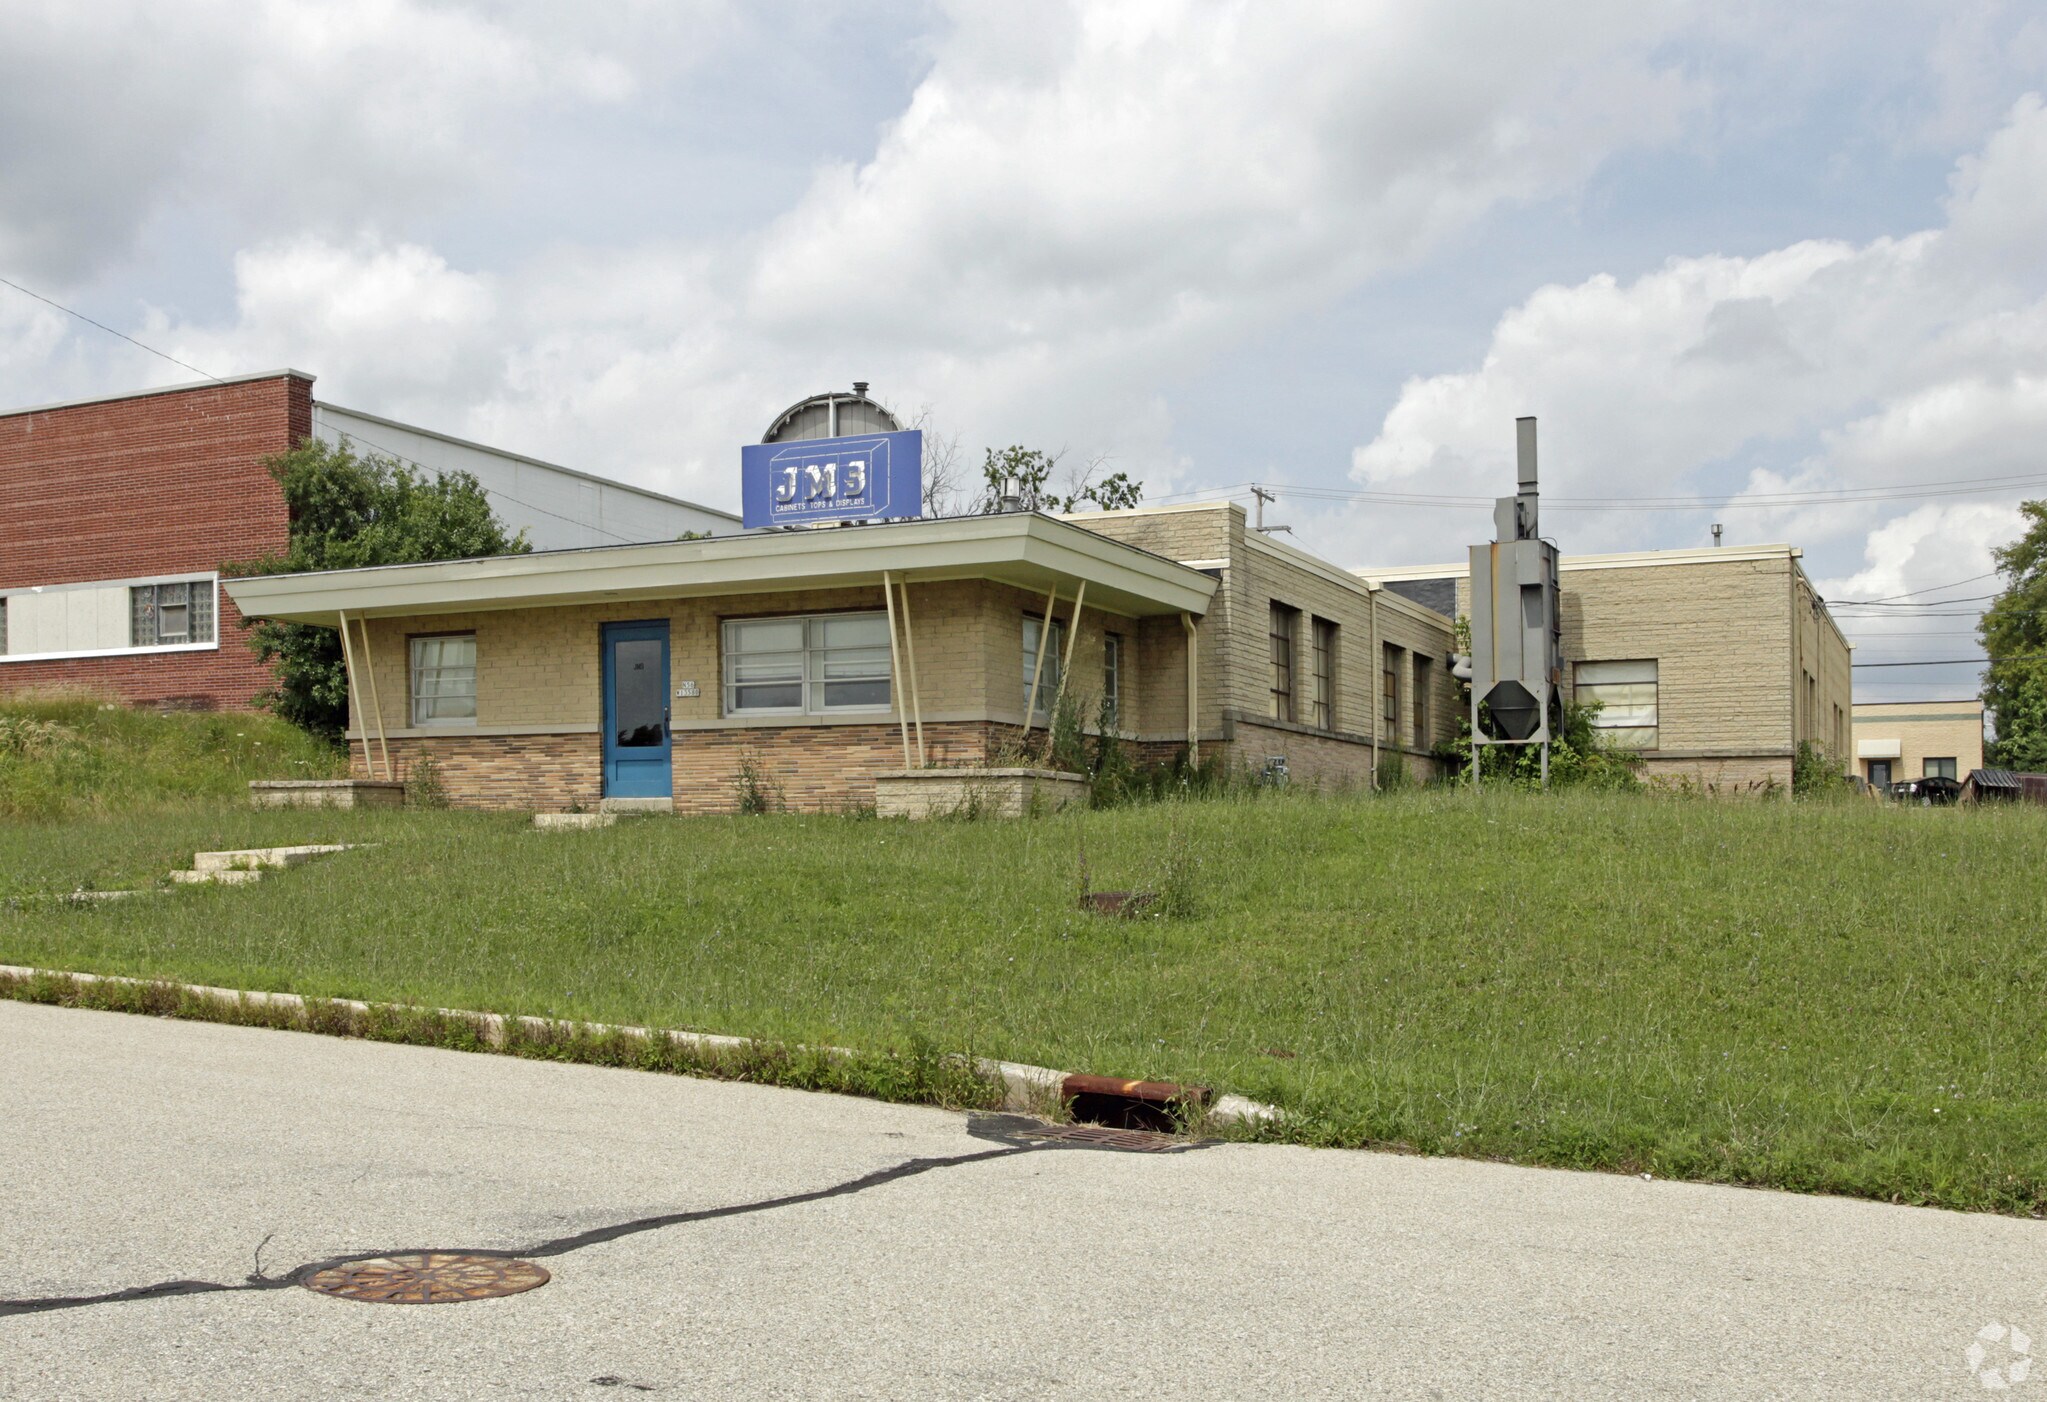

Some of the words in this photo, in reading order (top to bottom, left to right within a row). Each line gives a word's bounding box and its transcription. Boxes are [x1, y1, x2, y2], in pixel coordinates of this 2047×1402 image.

[775, 502, 806, 513] CABINETS
[810, 500, 826, 509] TOPS
[835, 497, 865, 507] DISPLAYS
